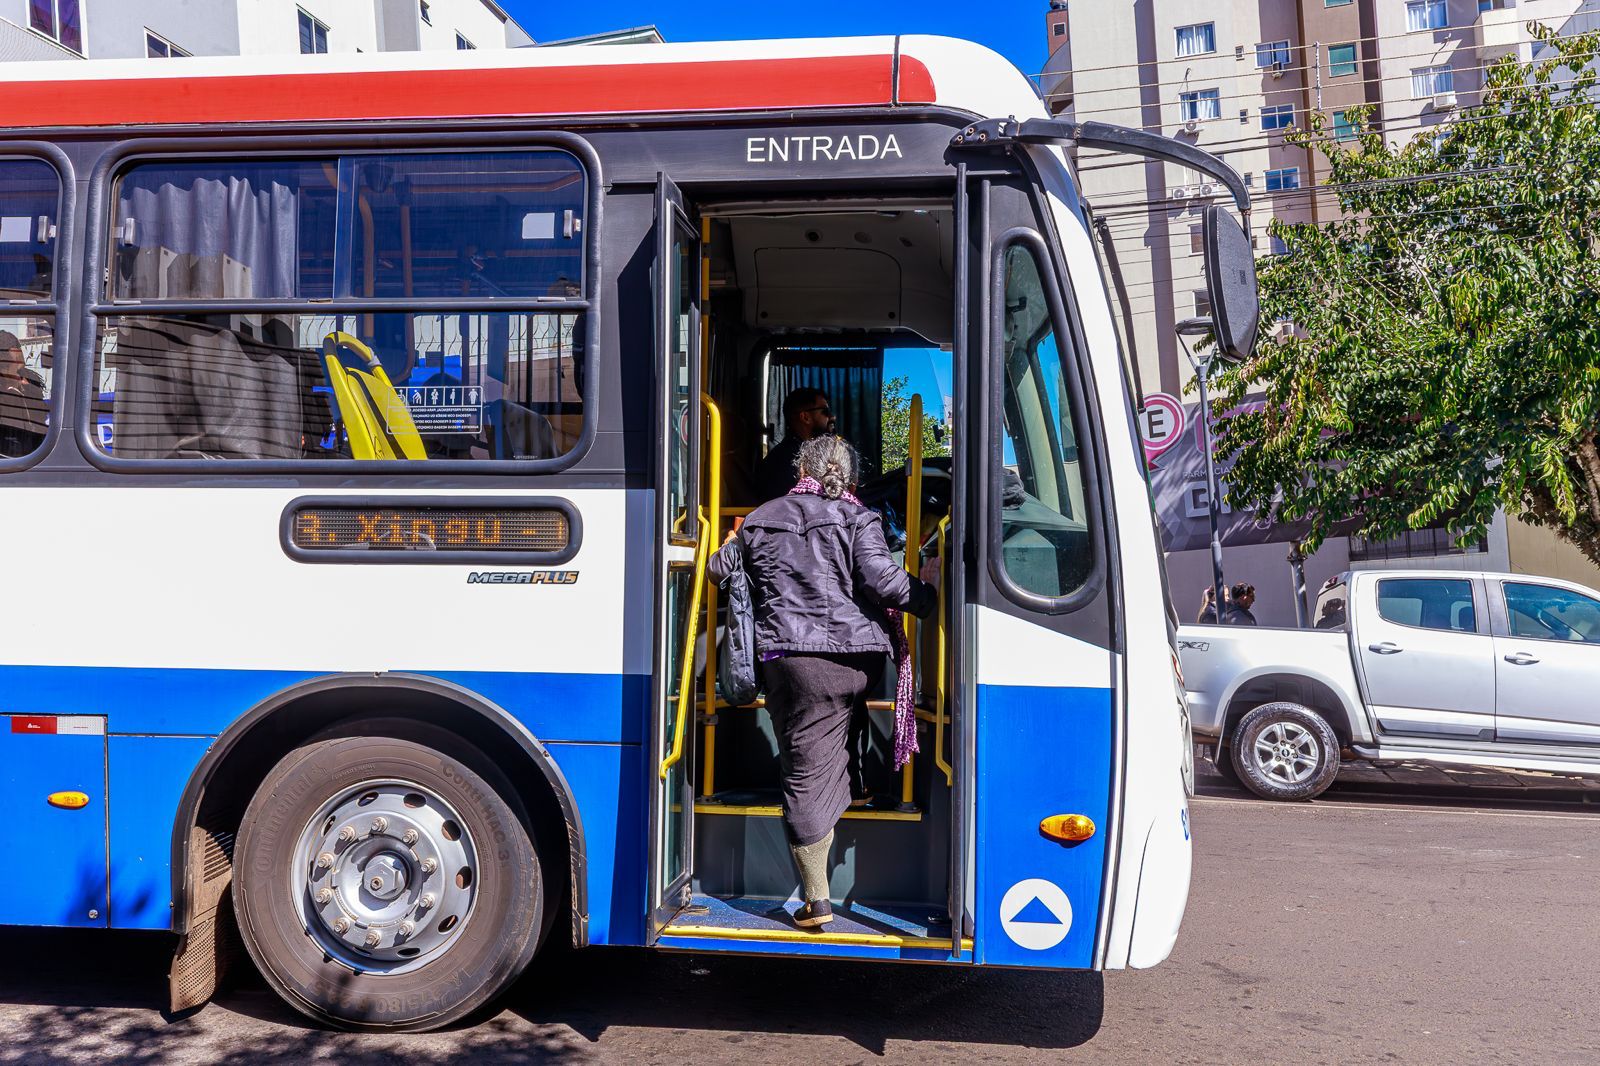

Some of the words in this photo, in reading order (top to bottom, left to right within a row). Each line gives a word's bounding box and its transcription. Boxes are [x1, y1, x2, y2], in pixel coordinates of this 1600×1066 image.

[746, 133, 903, 162] ENTRADA
[1147, 409, 1166, 438] E
[357, 514, 501, 543] Xingu
